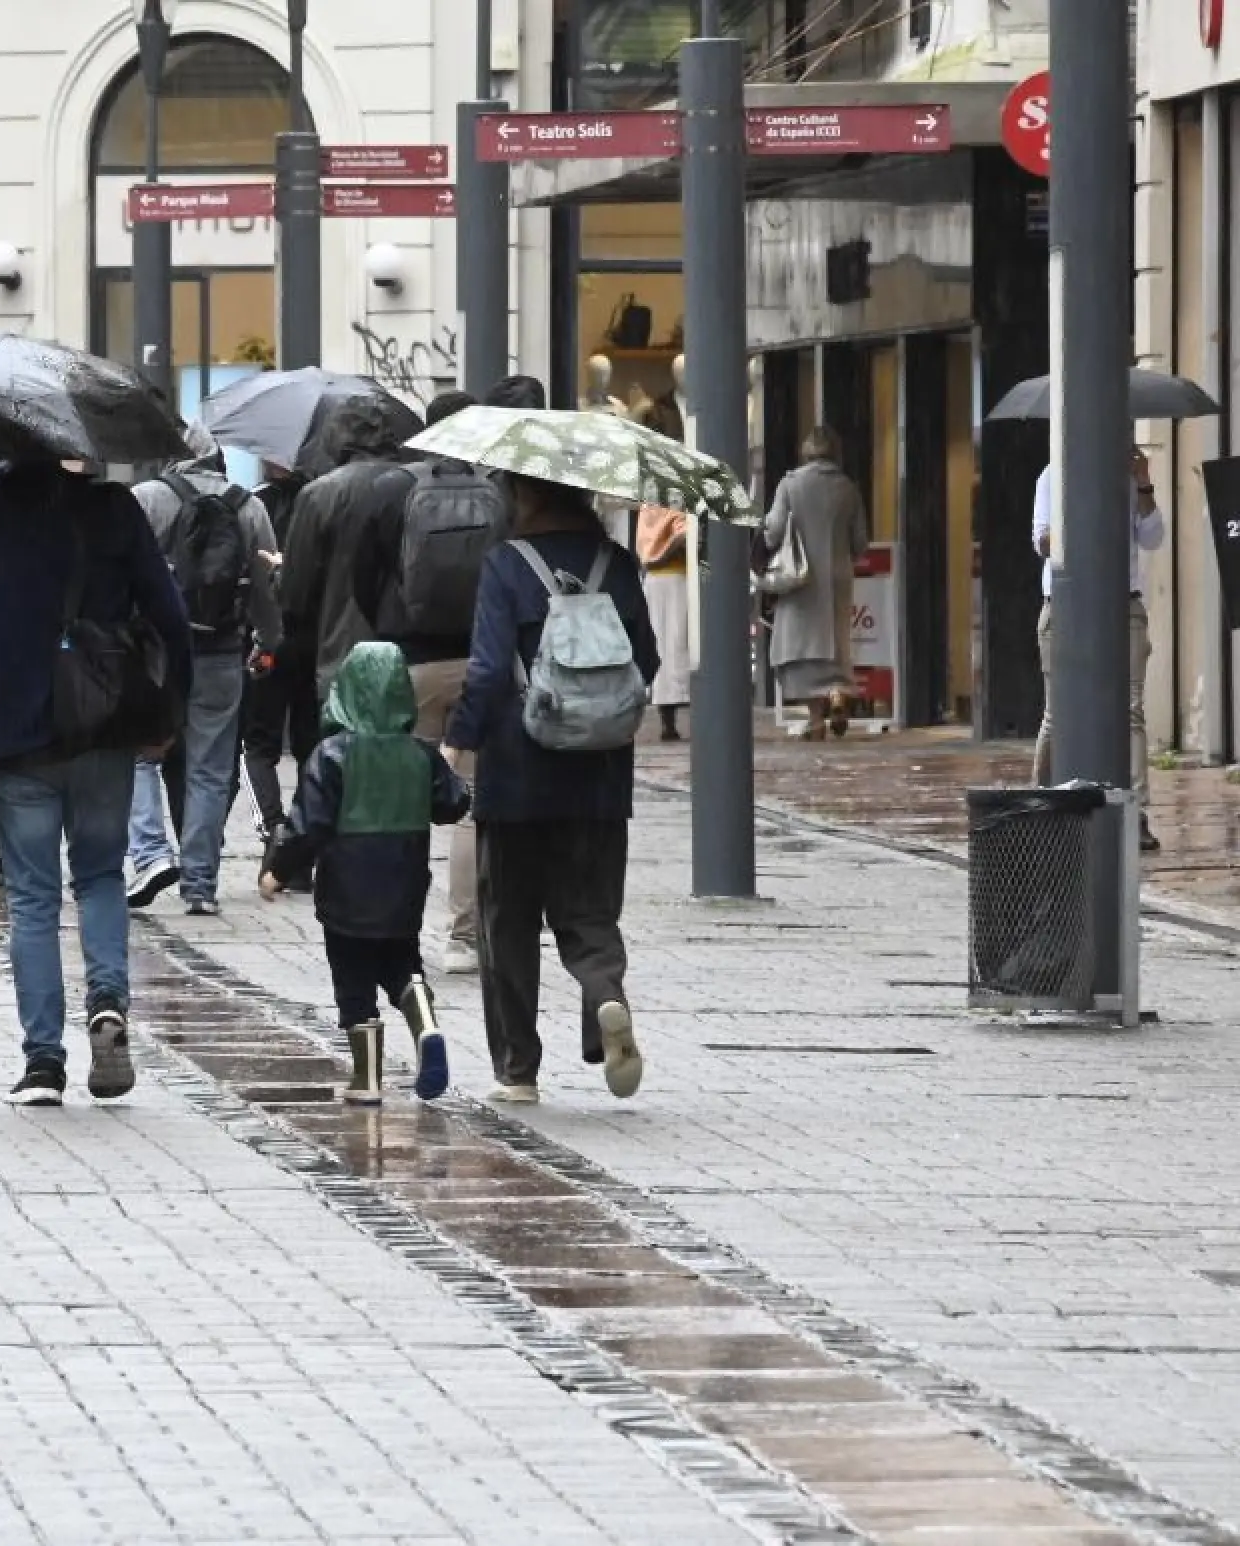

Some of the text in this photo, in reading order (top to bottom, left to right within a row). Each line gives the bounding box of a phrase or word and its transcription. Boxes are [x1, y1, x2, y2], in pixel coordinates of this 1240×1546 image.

[765, 113, 839, 125] Centro Cultural
[528, 124, 575, 140] Teatro
[765, 126, 778, 138] de
[161, 195, 198, 208] Parque
